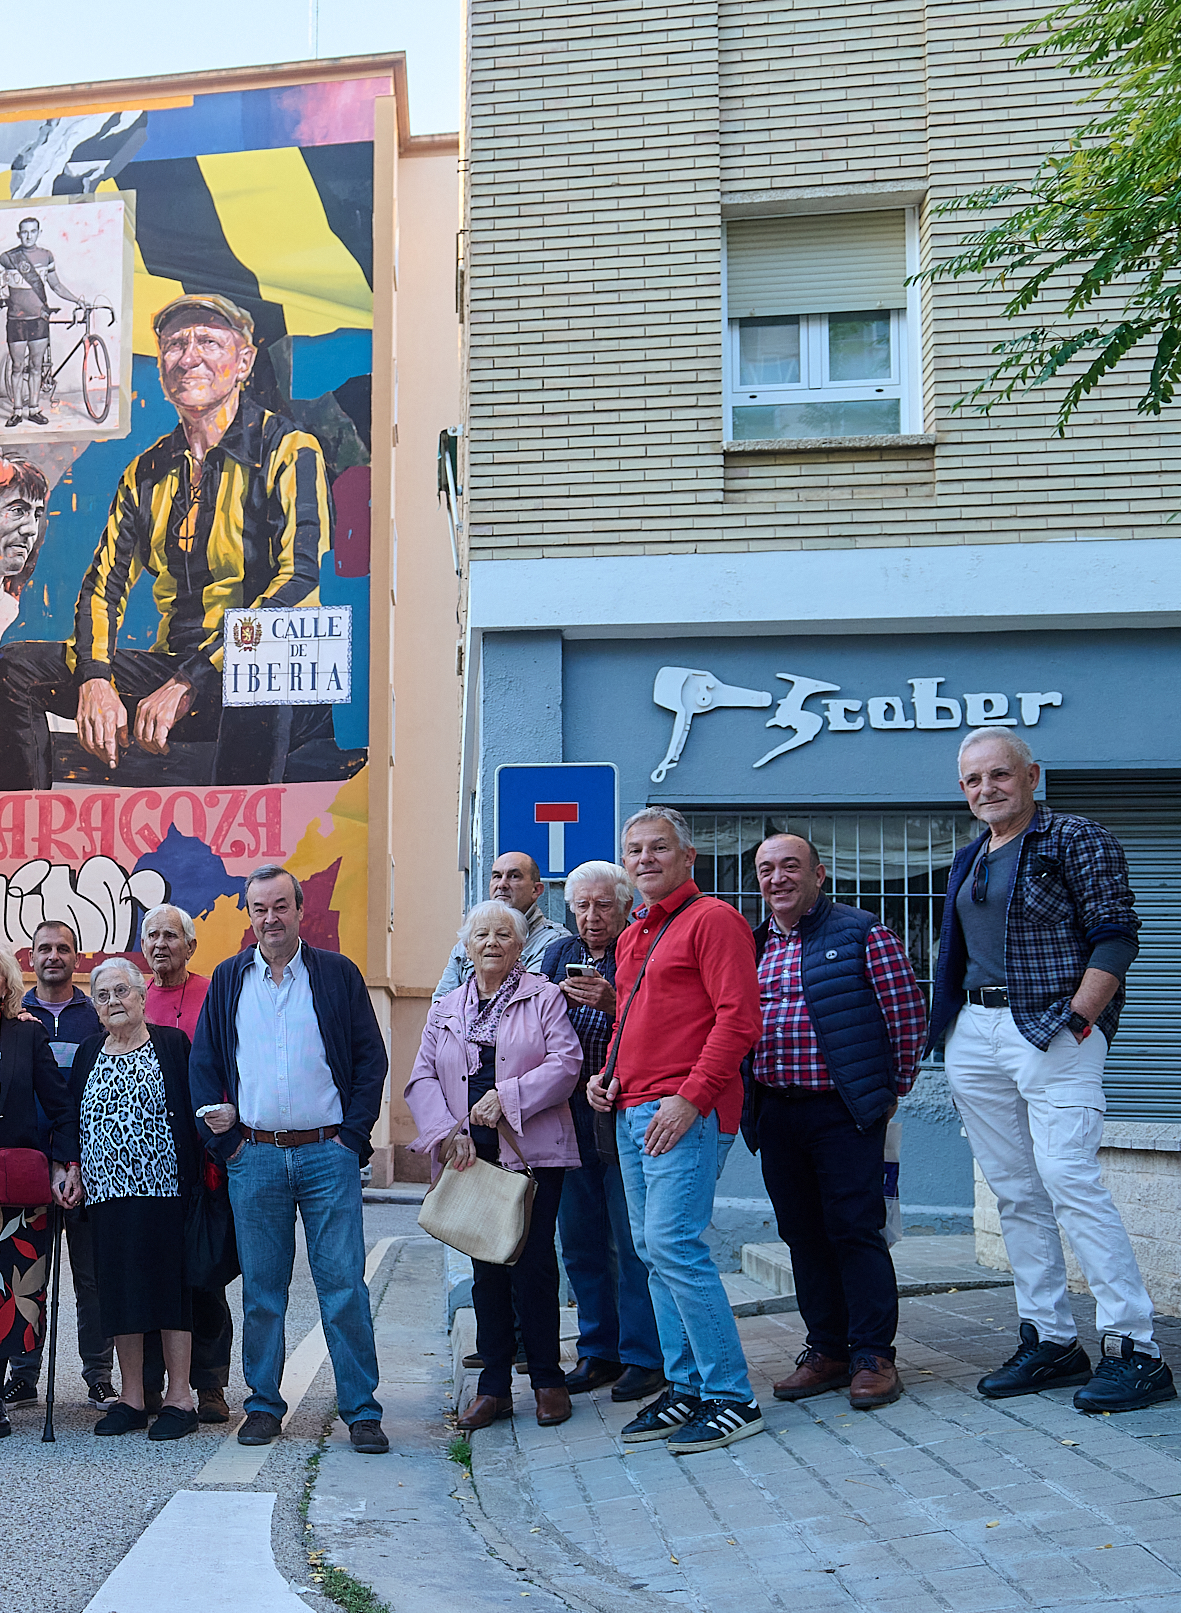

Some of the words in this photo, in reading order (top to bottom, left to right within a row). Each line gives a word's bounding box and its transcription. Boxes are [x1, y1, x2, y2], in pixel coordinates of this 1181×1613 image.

[271, 615, 342, 639] CALLE
[289, 643, 308, 658] DE
[231, 661, 344, 694] IBERIA
